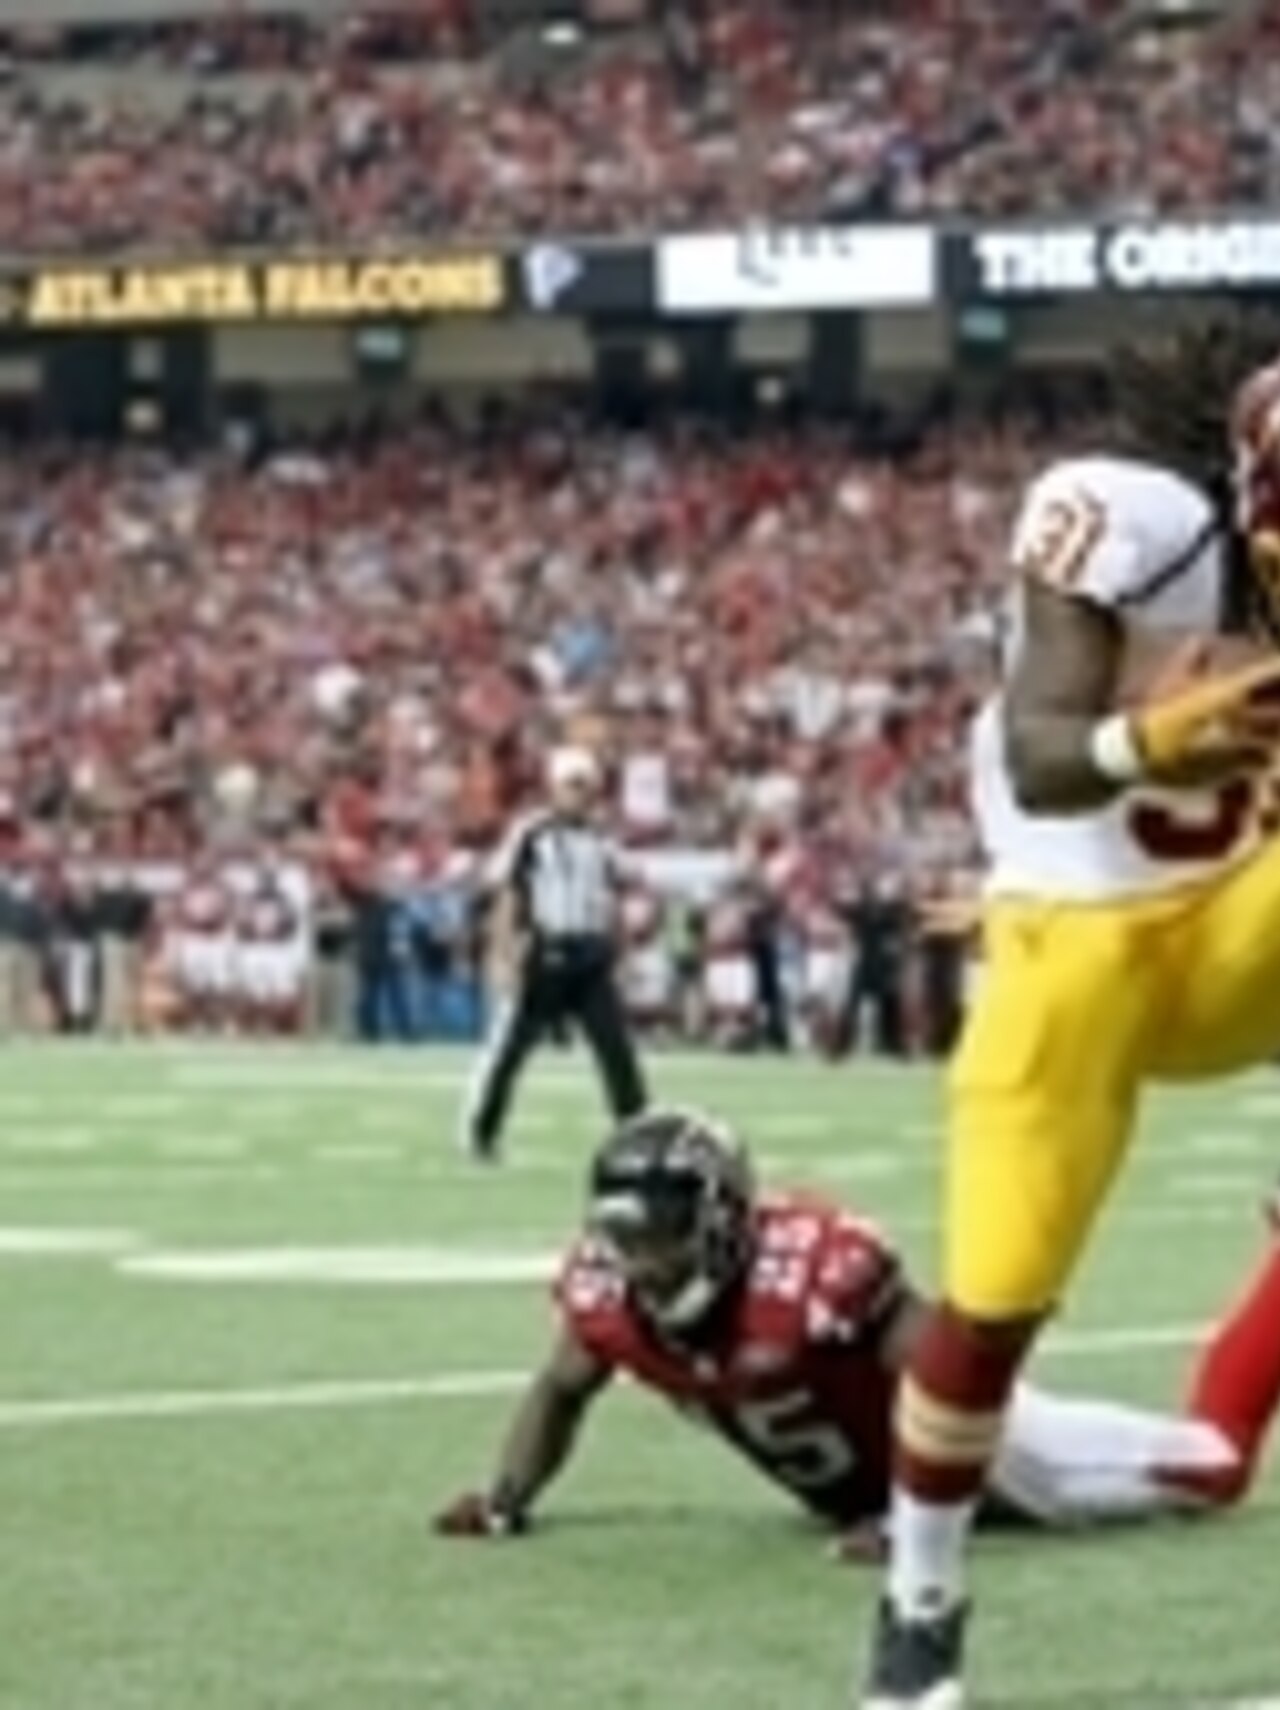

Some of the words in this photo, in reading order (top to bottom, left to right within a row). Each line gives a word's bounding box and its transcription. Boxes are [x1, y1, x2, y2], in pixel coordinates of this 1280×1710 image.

[28, 265, 252, 325] ATLANTA
[265, 256, 501, 318] FALCONS
[974, 228, 1097, 290] THE
